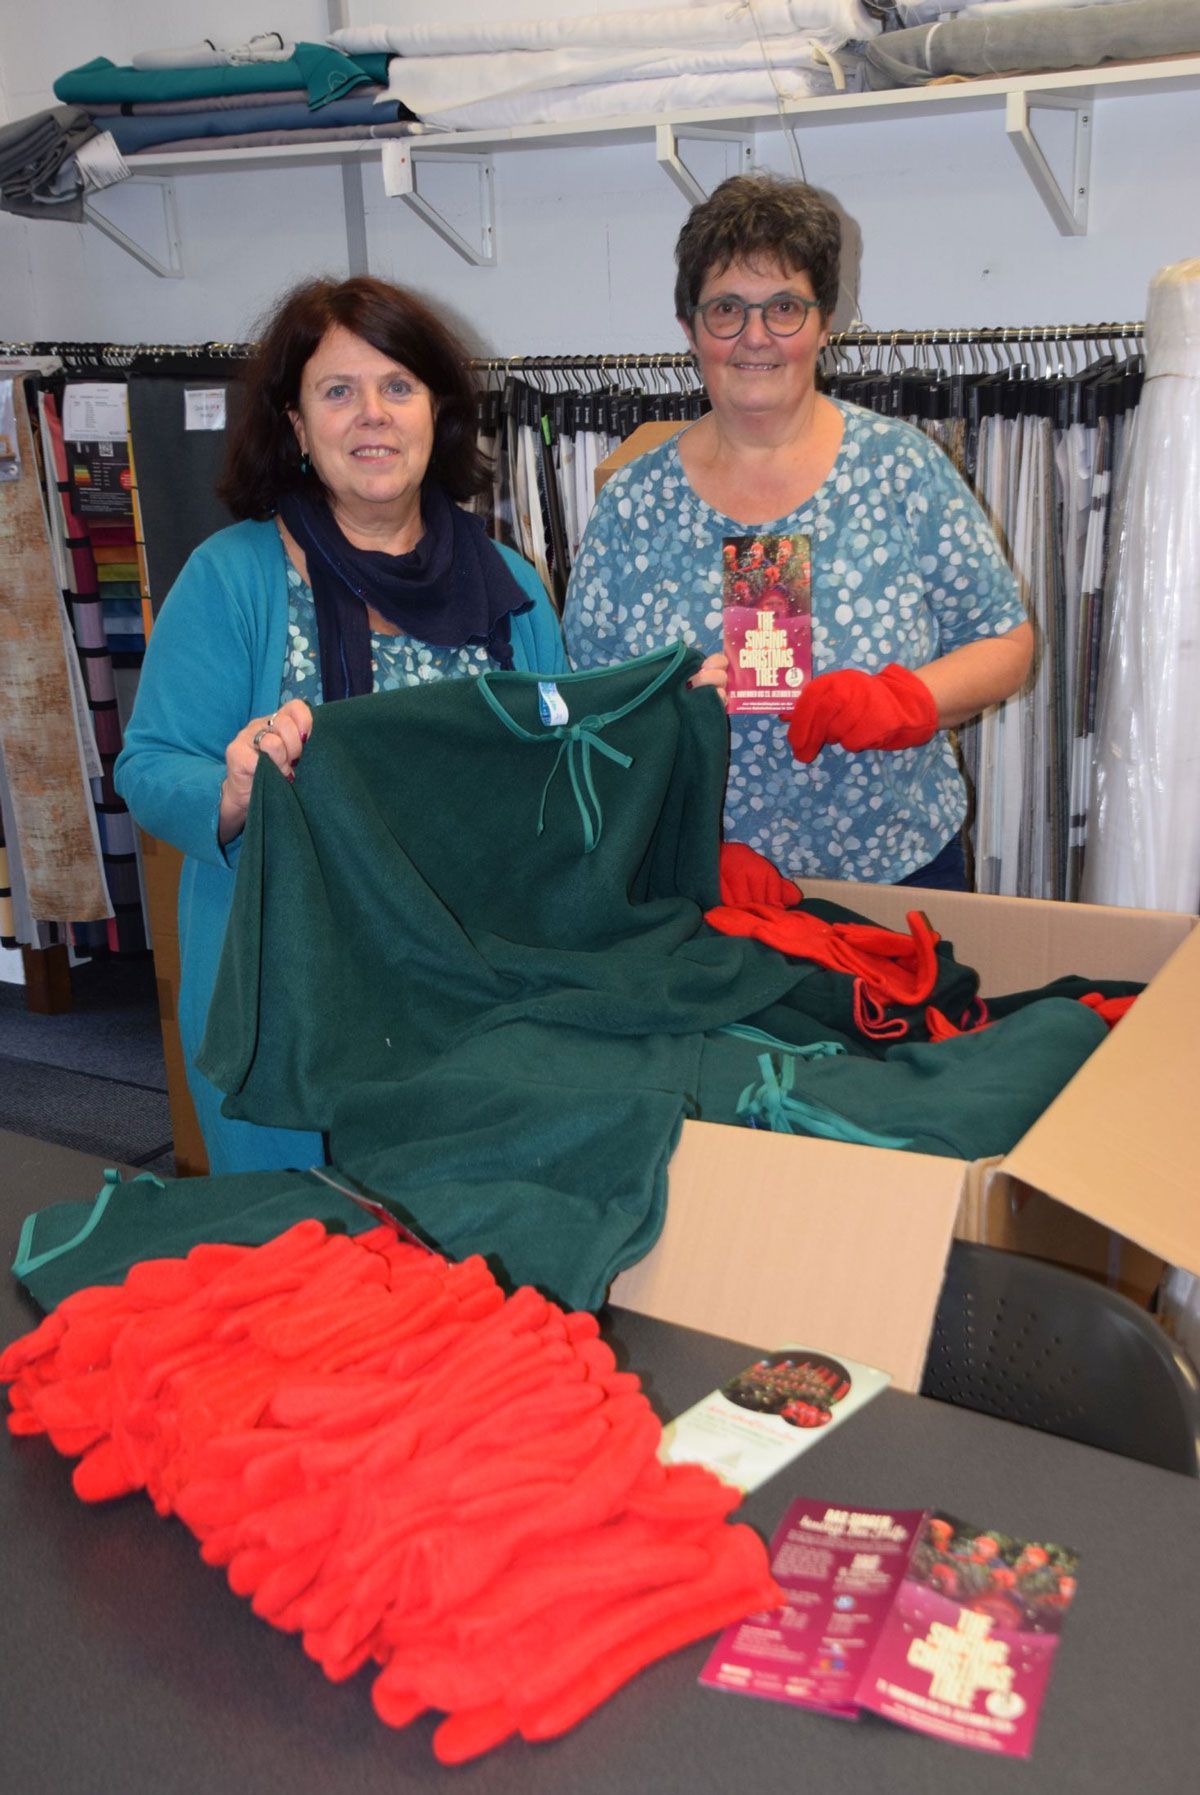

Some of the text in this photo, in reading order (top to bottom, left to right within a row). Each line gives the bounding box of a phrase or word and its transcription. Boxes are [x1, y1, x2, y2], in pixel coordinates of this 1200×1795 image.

[756, 611, 775, 630] THE
[745, 629, 787, 649] SINGING
[739, 648, 794, 668] CHRISTMAS
[755, 667, 779, 687] TREE
